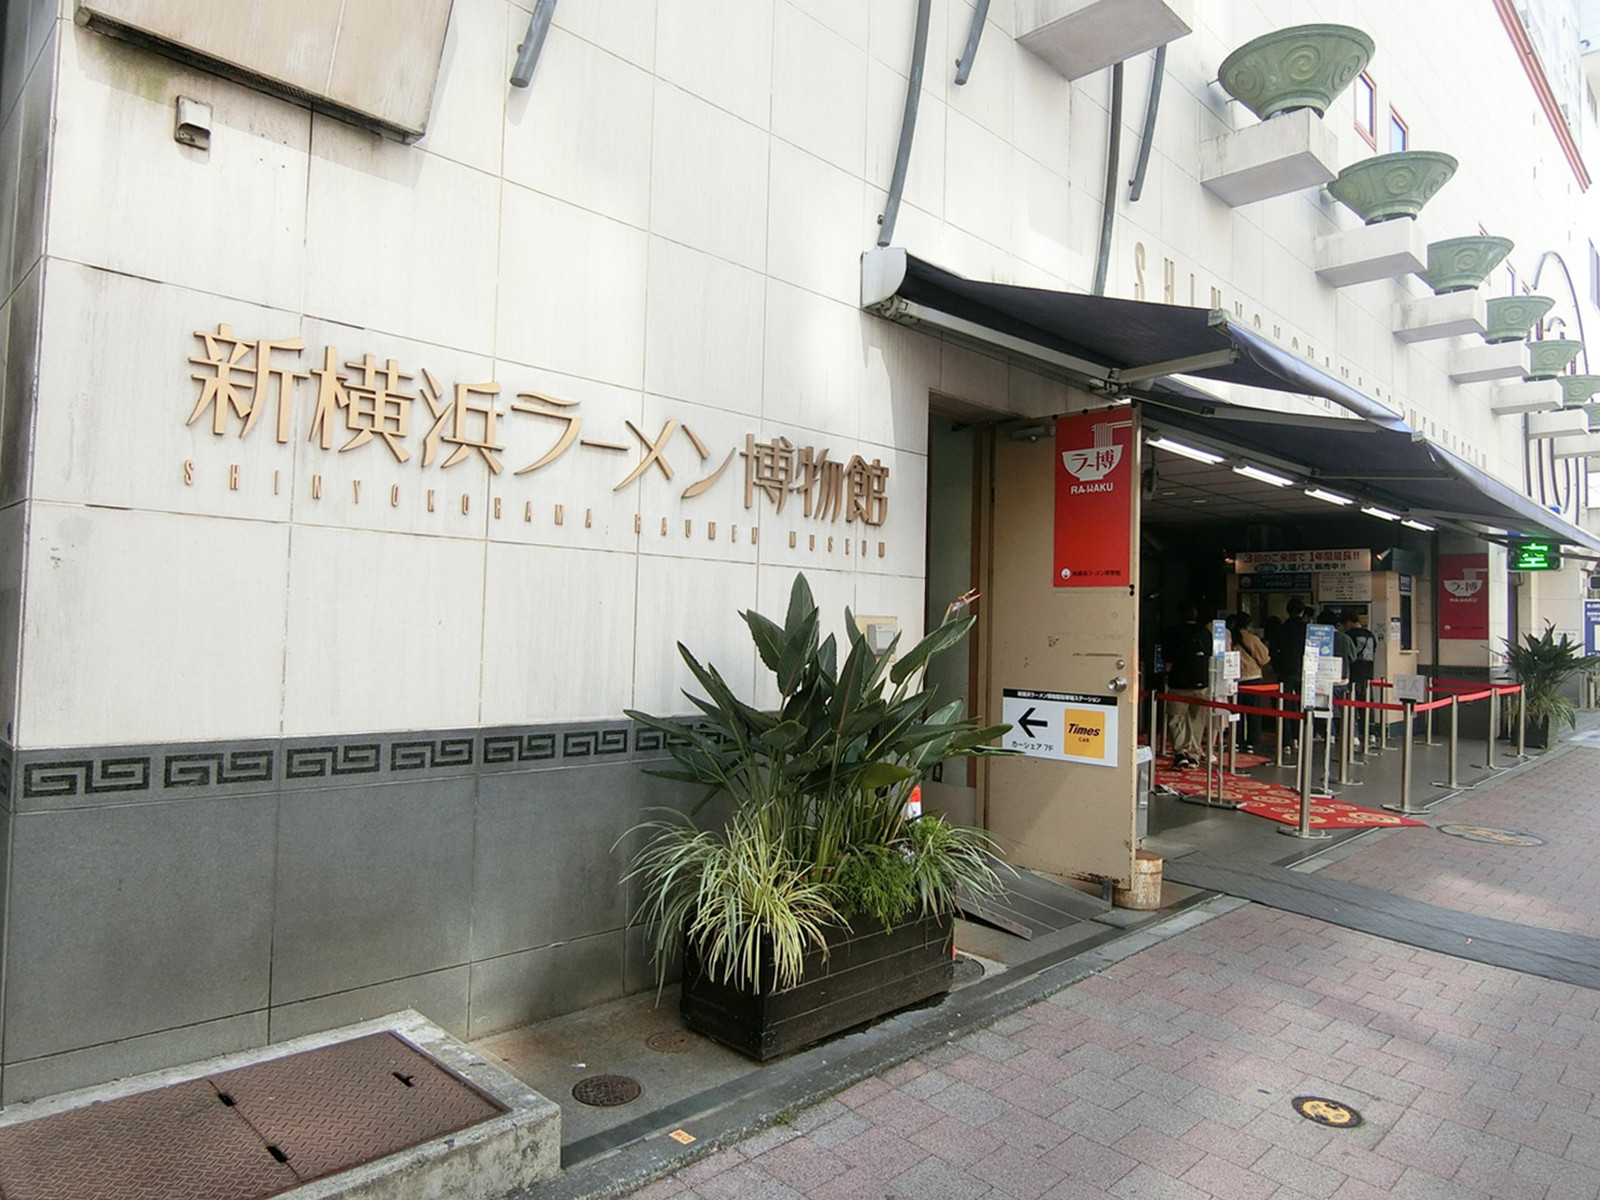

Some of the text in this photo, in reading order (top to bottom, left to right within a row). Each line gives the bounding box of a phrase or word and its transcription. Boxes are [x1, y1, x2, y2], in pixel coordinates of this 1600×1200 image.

[186, 322, 890, 527] 新横浜ラーメン博物館
[1071, 448, 1115, 474] ラー博
[183, 459, 593, 528] SHINYOKOHAMA
[1068, 723, 1101, 737] Times
[1011, 740, 1042, 750] カーシェア
